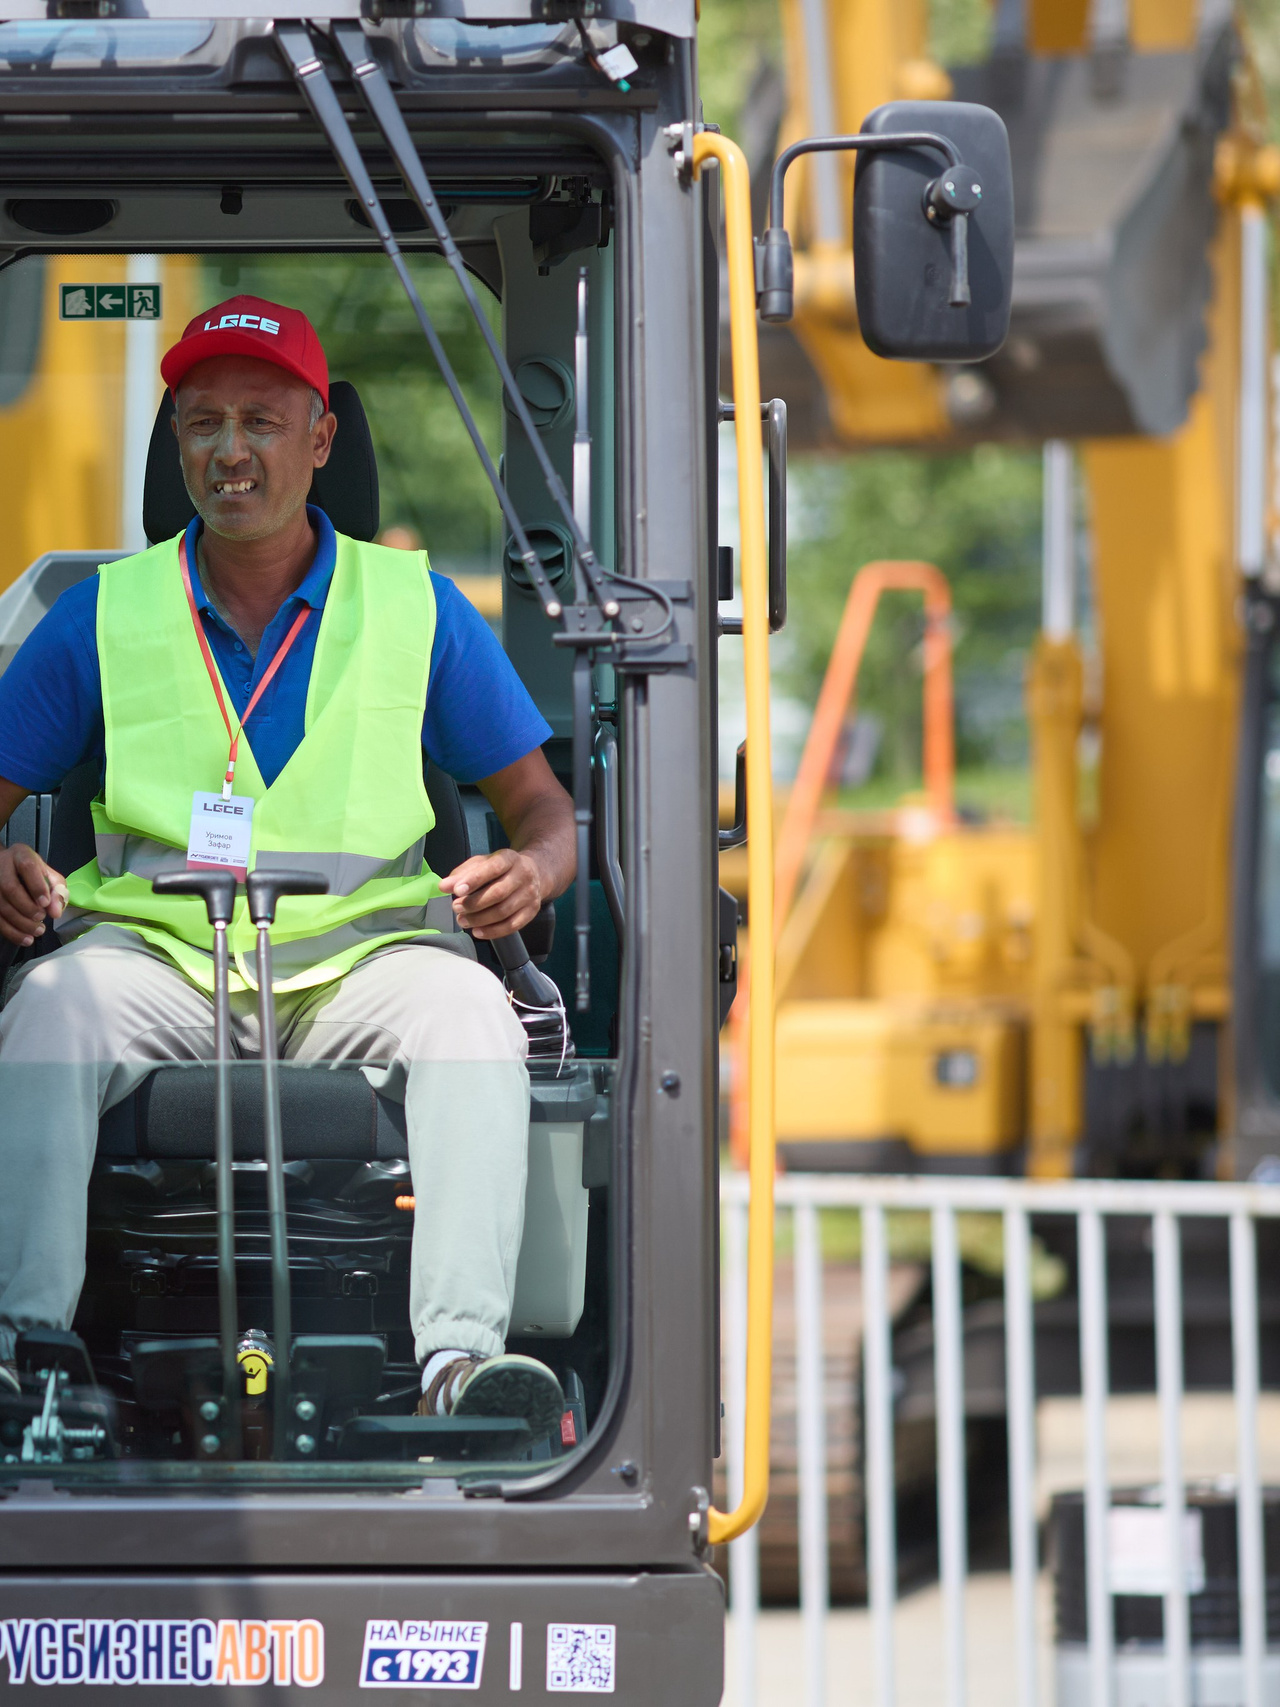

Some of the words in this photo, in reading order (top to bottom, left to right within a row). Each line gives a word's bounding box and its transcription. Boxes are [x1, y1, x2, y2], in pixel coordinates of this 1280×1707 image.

[203, 314, 281, 335] LGCE
[203, 802, 244, 815] LGCE
[205, 831, 233, 840] Уримов
[207, 840, 231, 850] Зафар
[370, 1624, 397, 1641] НА
[405, 1625, 483, 1642] РЫНКЕ
[395, 1649, 470, 1682] 1993
